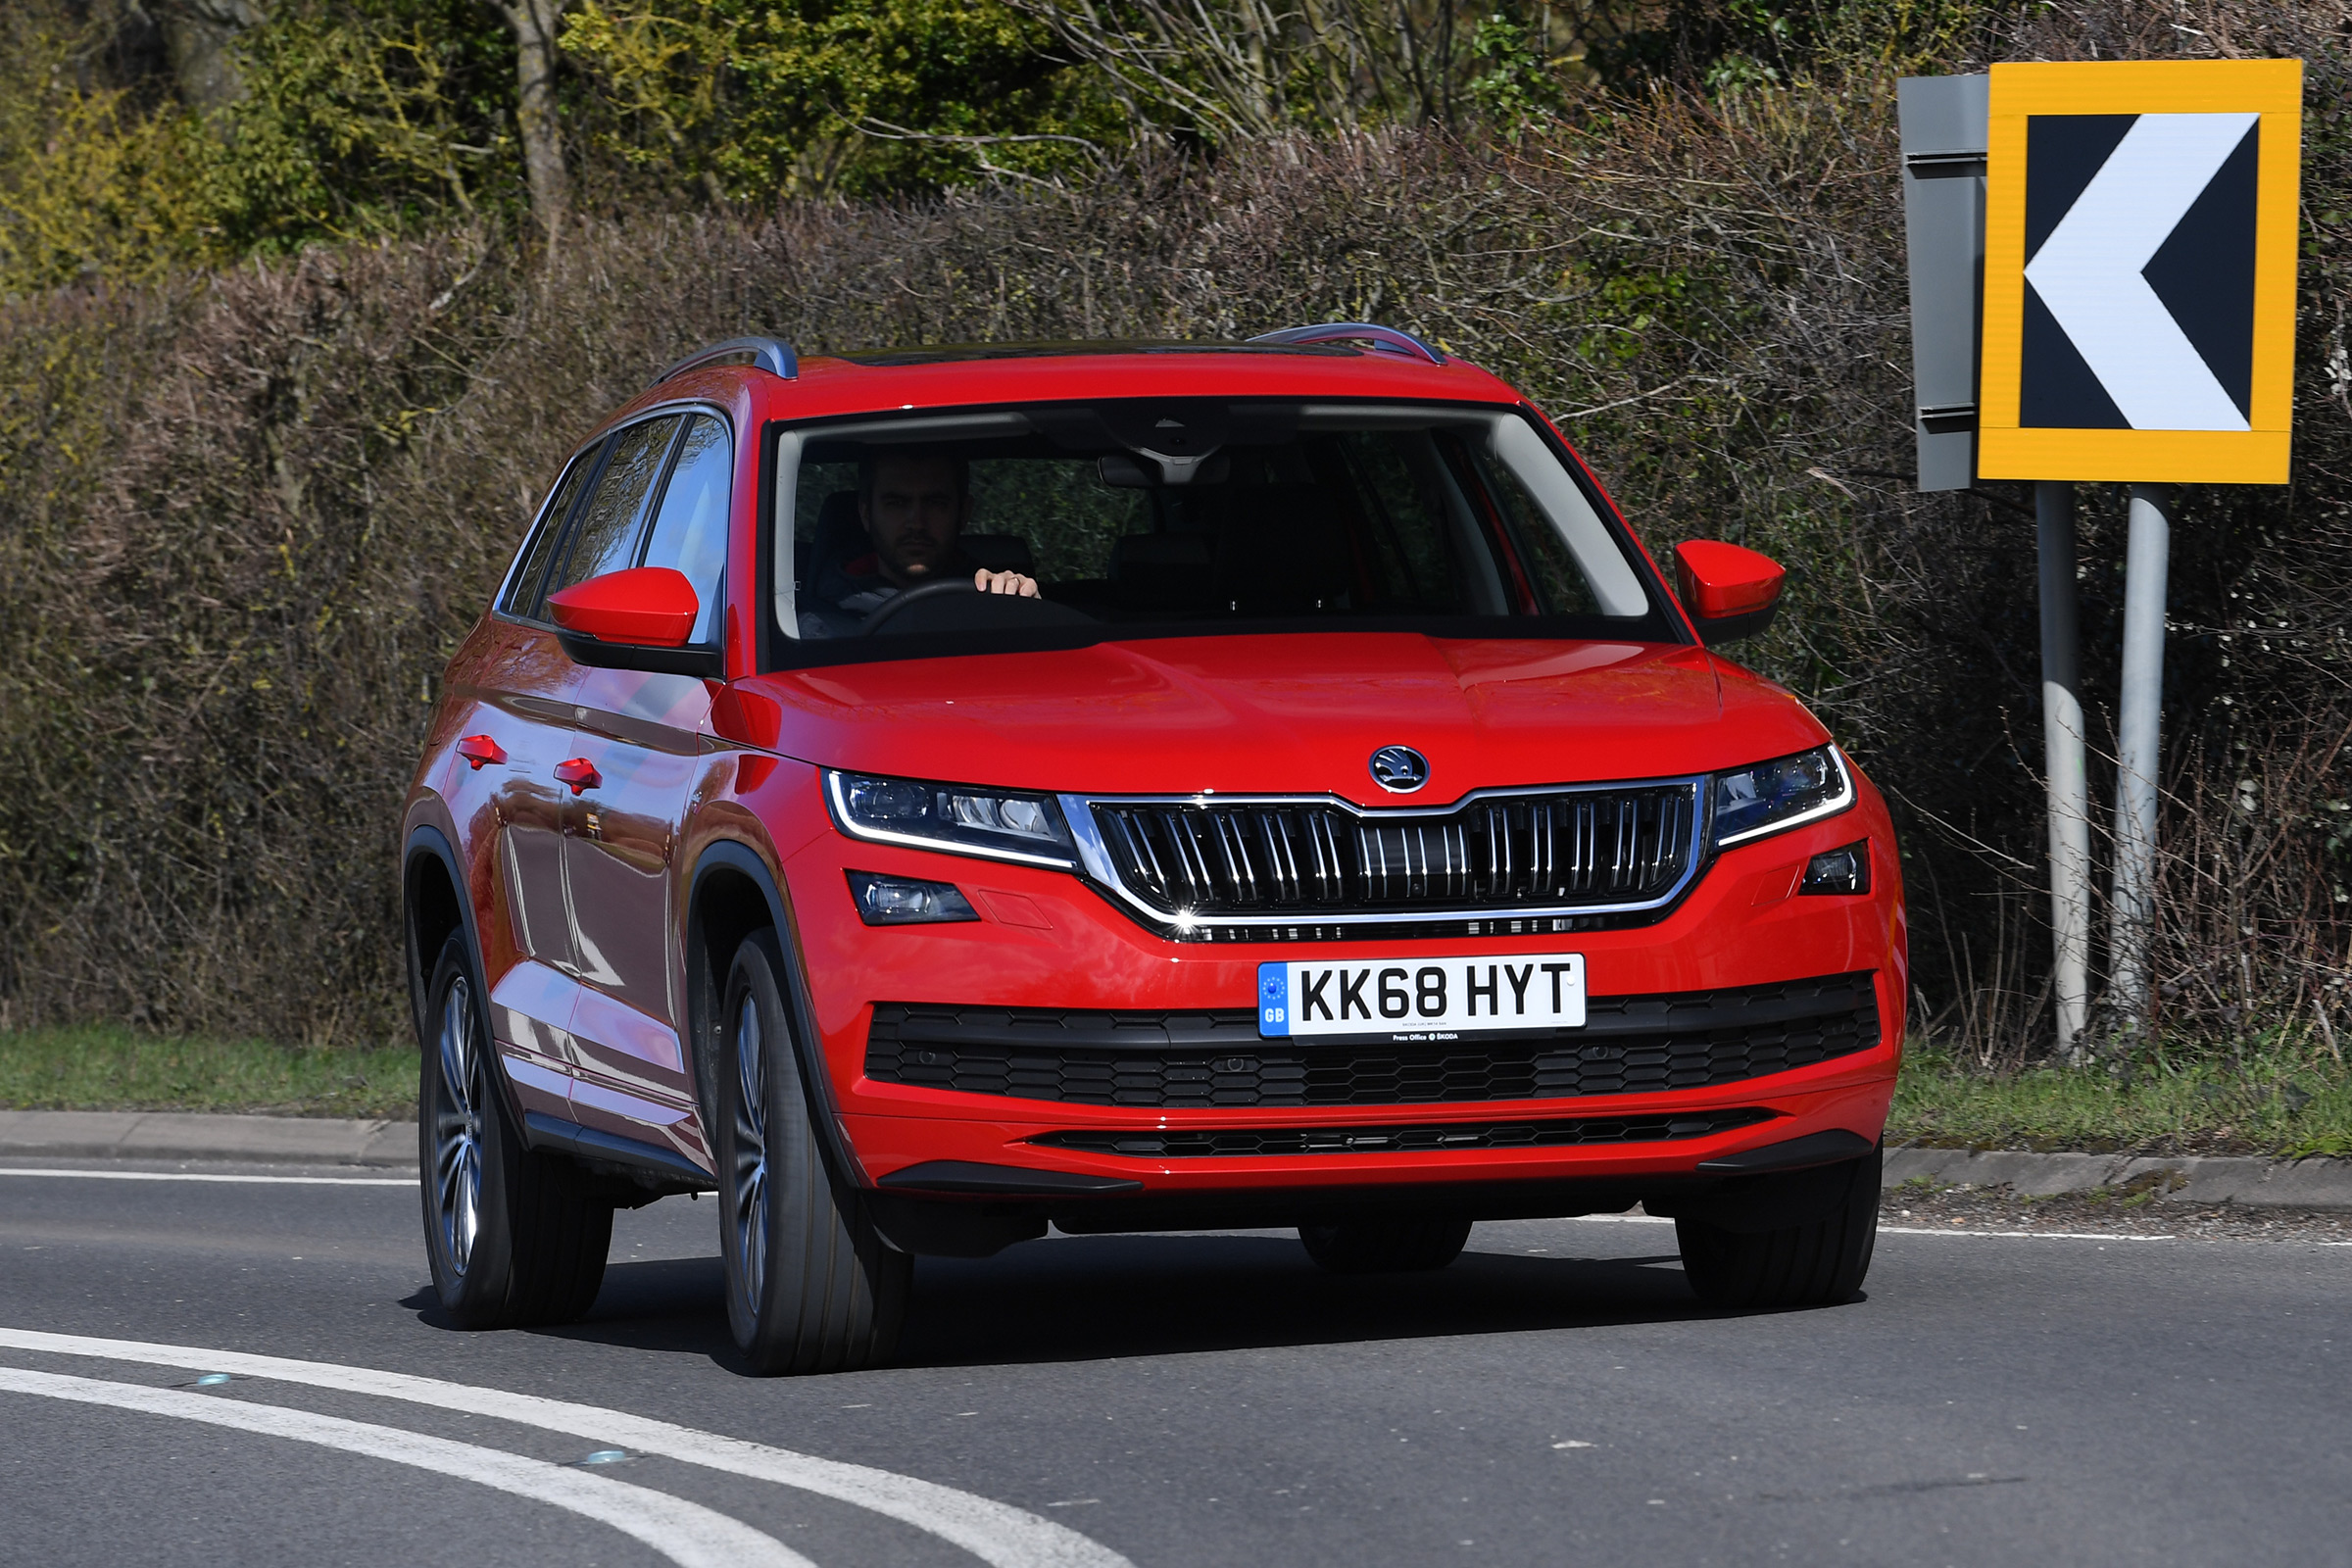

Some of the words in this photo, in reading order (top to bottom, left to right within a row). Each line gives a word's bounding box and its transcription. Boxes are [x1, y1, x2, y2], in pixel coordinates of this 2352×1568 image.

[1300, 966, 1447, 1021] KK68
[1466, 962, 1571, 1016] HYT
[1264, 1007, 1285, 1023] GB
